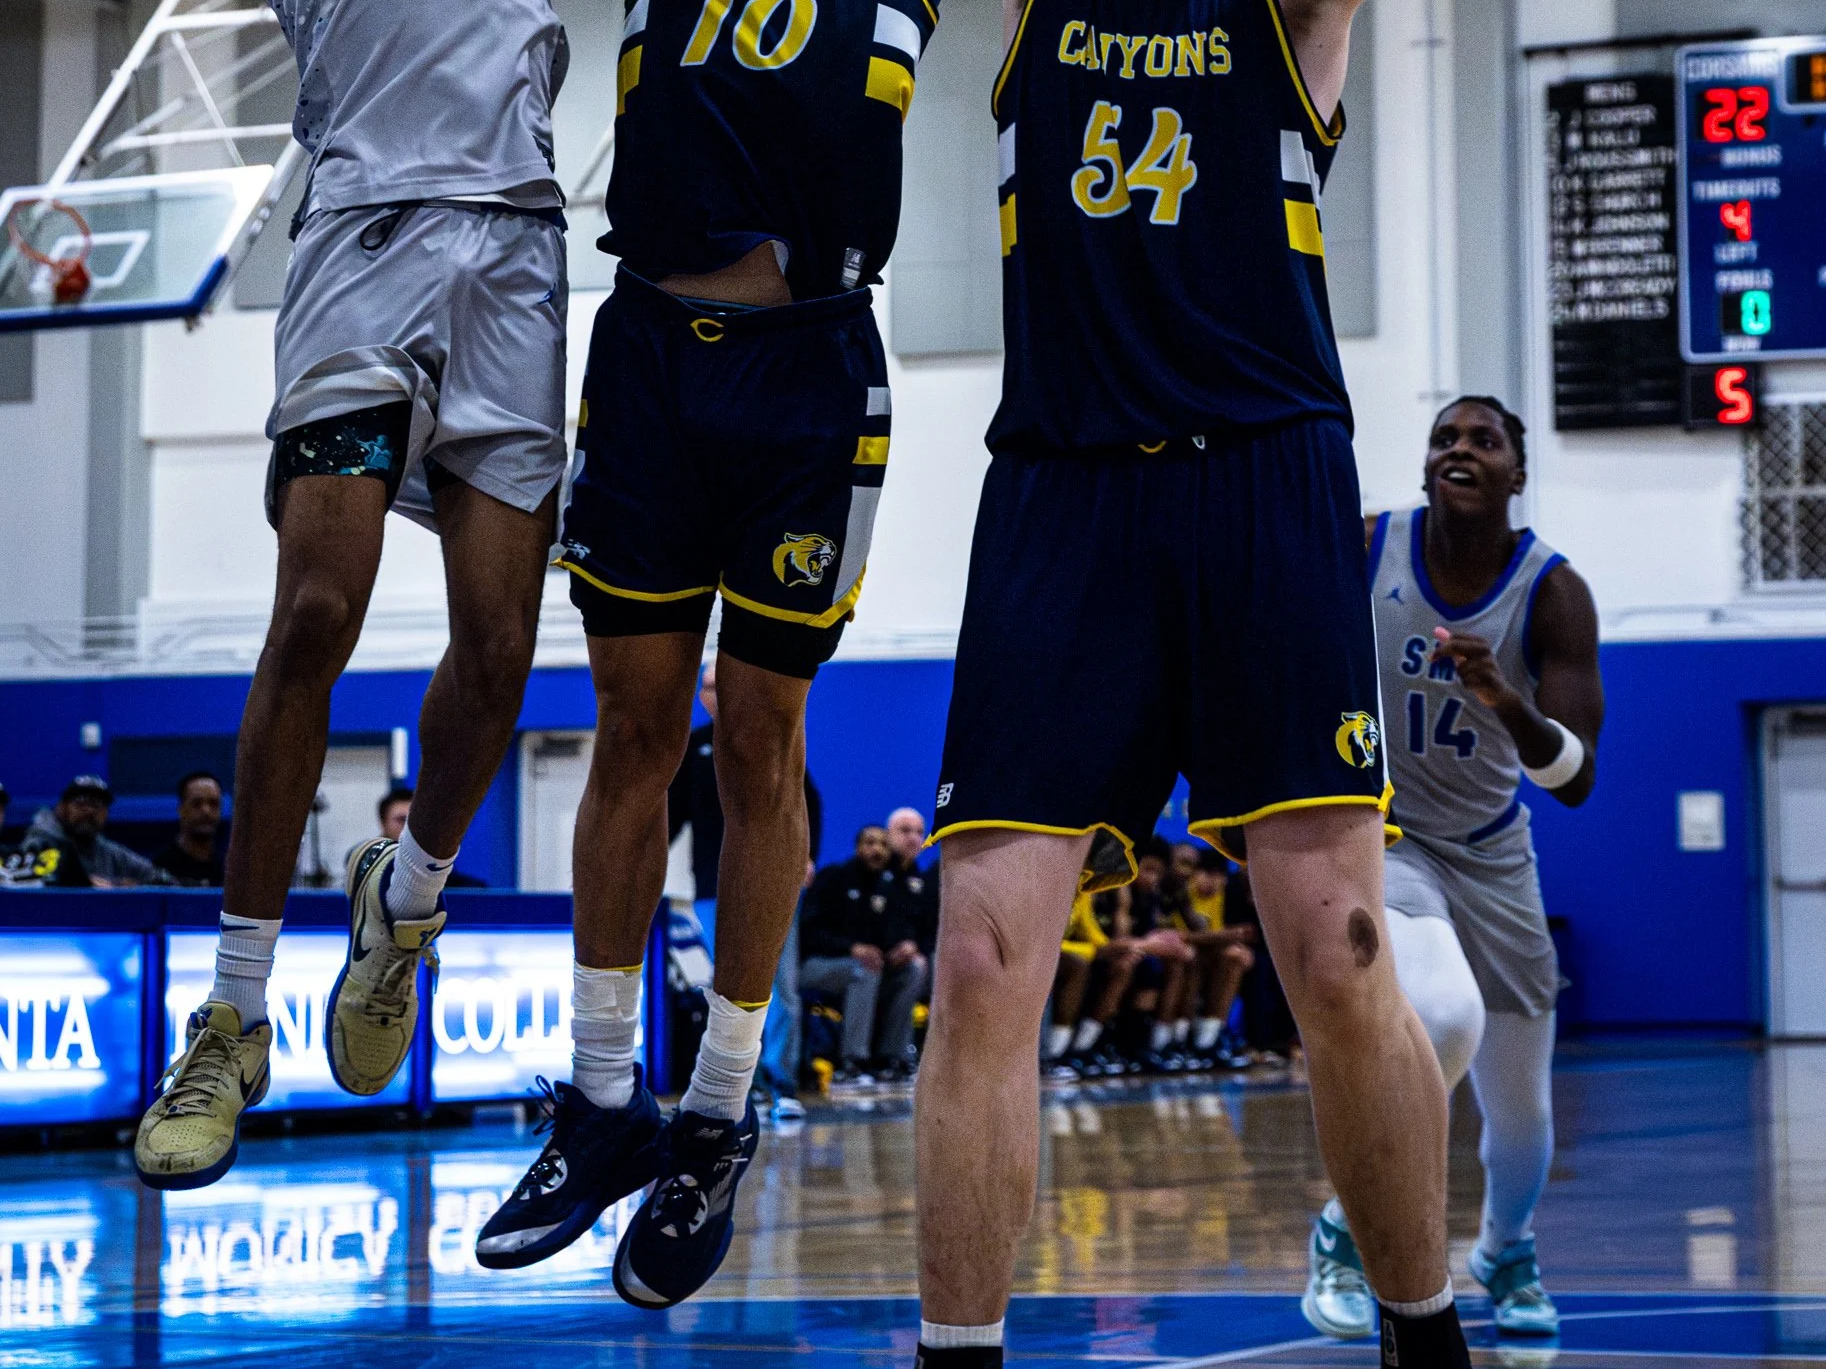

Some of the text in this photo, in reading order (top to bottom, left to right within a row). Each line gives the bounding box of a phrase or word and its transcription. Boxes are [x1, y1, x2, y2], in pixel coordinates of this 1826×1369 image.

[1702, 85, 1770, 144] 22
[1070, 99, 1198, 226] 54
[1692, 177, 1781, 201] TIMEOUTS
[1719, 198, 1752, 243] 4
[1740, 290, 1772, 336] 0
[1714, 367, 1753, 425] 5
[1401, 635, 1460, 682] SM
[1405, 689, 1479, 760] 14
